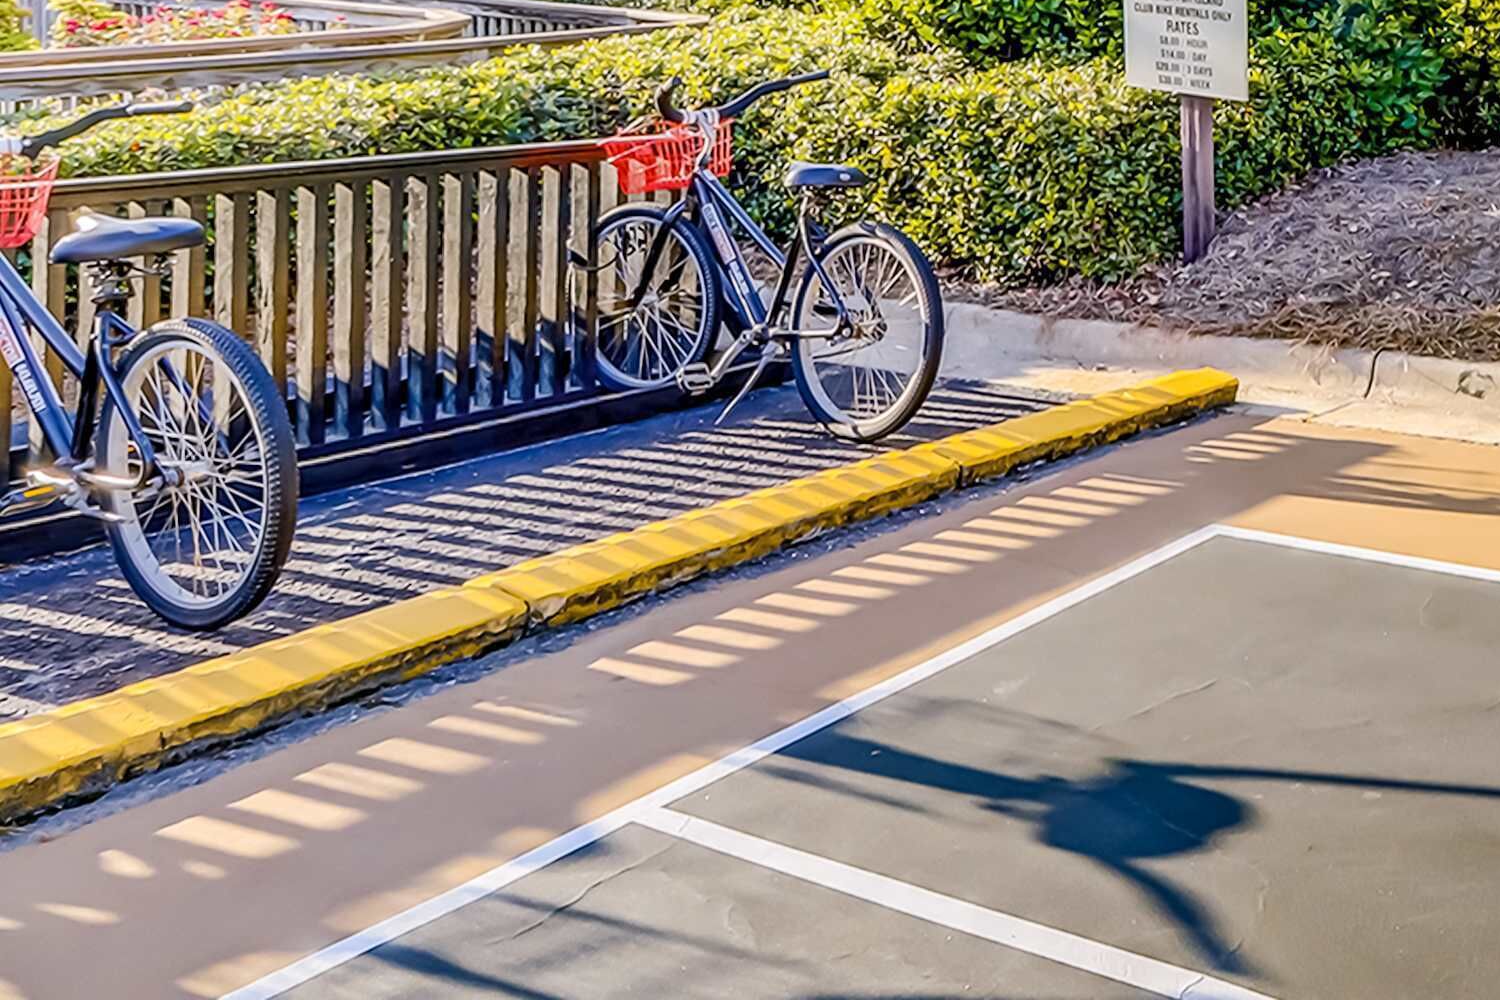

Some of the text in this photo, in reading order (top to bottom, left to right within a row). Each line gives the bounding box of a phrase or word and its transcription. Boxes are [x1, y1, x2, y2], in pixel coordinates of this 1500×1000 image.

[1134, 2, 1232, 21] CLUB BIKE RENTALS ONLY
[1166, 20, 1199, 36] RATES
[1186, 39, 1208, 48] HOUR
[1192, 52, 1207, 62] DAY
[1193, 66, 1213, 77] DAYS
[1190, 80, 1210, 89] WEEK
